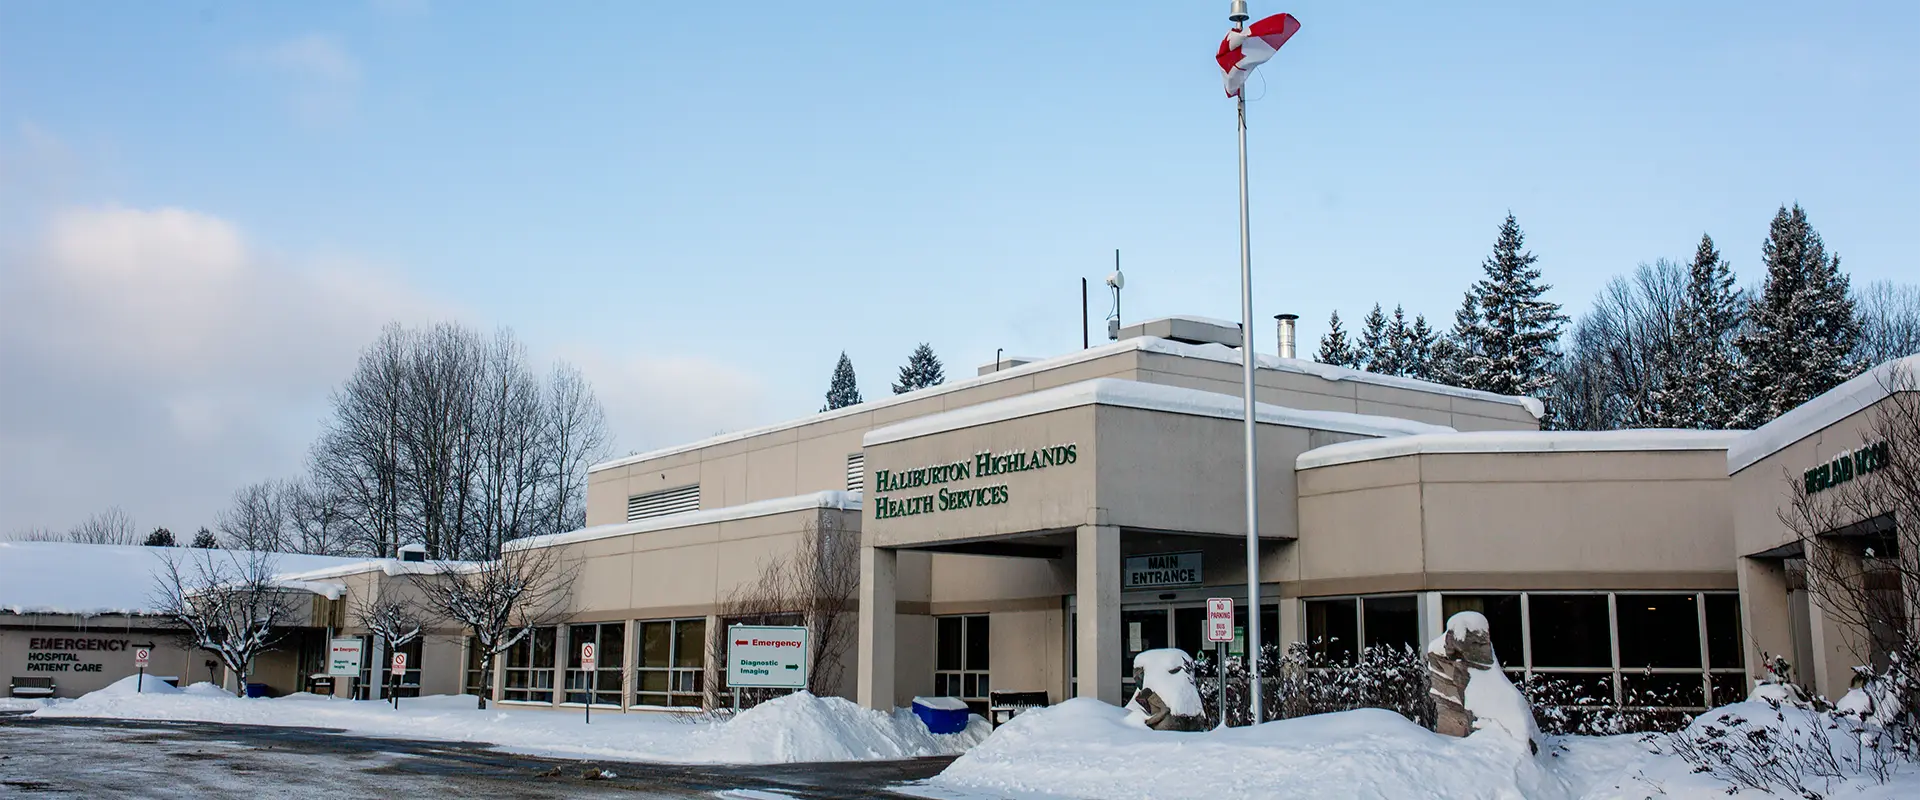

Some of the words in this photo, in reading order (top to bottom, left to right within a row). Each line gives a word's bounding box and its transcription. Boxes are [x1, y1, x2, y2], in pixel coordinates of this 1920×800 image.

[1148, 555, 1179, 569] MAIN
[1132, 569, 1195, 584] ENTRANCE
[29, 638, 130, 651] EMERGENCY
[752, 639, 801, 648] Emergency
[28, 652, 80, 662] HOSPITAL
[27, 663, 70, 672] PATIENT
[73, 664, 103, 672] CARE
